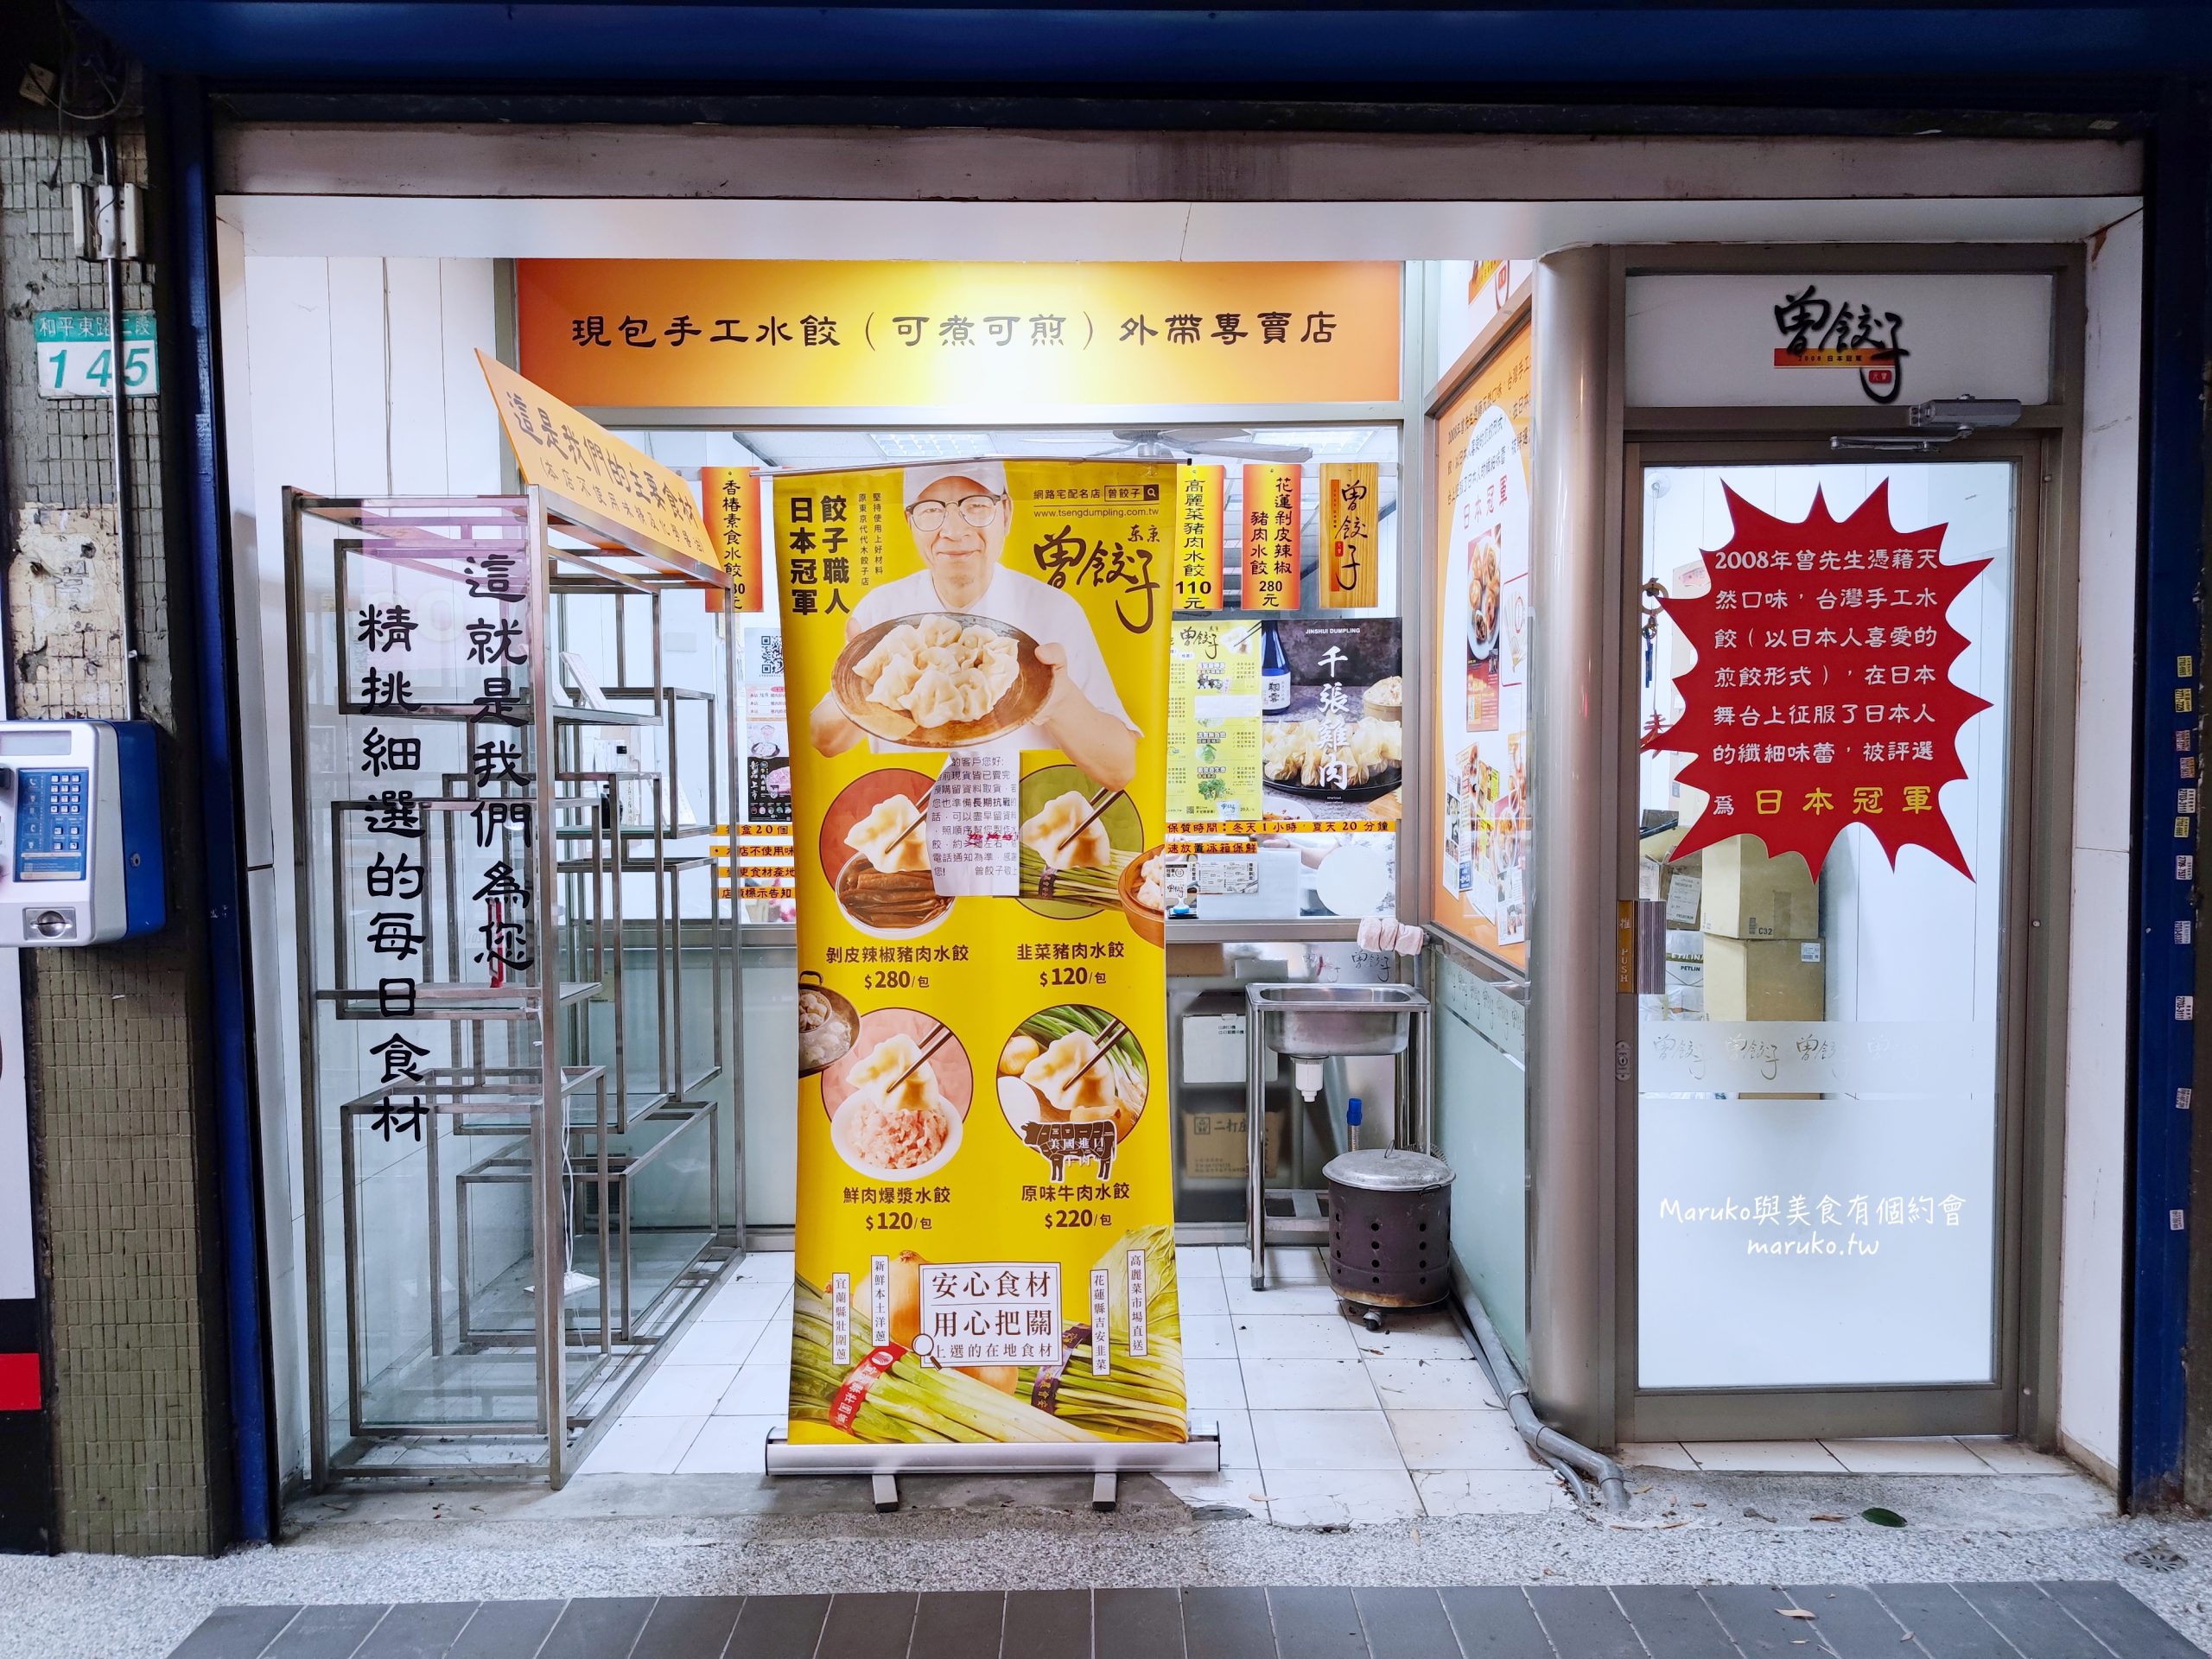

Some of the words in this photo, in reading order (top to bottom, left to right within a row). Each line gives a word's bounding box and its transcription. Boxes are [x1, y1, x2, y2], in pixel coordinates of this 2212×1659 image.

[40, 316, 150, 337] 和平東路二段
[506, 391, 699, 529] 這是我們的主要食材
[1033, 488, 1101, 500] 網路宅配名店
[1108, 488, 1141, 499] 曾餃子
[1033, 508, 1160, 518] www.tsengdumpling.com.tw
[722, 480, 742, 578] 香椿素食水餃
[873, 493, 883, 575] 堅持使用上好材料
[1183, 479, 1205, 577] 高麗菜豬肉水餃
[1274, 477, 1294, 575] 花蓮剝皮辣椒
[859, 493, 869, 586] 原東京代代木餃子店
[1250, 511, 1269, 575] 豬肉水餃
[789, 497, 817, 615] 日本冠軍
[821, 494, 850, 614] 餃子職人
[1714, 548, 1938, 571] 2008年曾先生憑藉天
[1175, 581, 1211, 594] 110
[1259, 581, 1283, 592] 280
[1184, 597, 1205, 609] 元
[1262, 594, 1280, 607] 元
[1714, 587, 1938, 610] 然口味，台灣手工水
[1713, 626, 1938, 649] 餃（以日本人喜愛的
[1713, 665, 1936, 688] 煎餃形式），在日本
[1317, 645, 1350, 791] 千張雞肉
[1713, 703, 1936, 727] 舞台上征服了日本人
[465, 554, 535, 971] 這就是我們為您
[1713, 741, 1934, 765] 的纖細味蕾，被評選
[1756, 785, 1933, 816] 日本冠軍
[1167, 842, 1257, 854] 速放置冰箱保鮮
[357, 603, 430, 1143] 精挑細選的每日食材
[1619, 917, 1631, 930] 推
[826, 944, 969, 963] 剝皮辣椒豬肉水餃
[1016, 941, 1125, 961] 韭菜豬肉水餃
[1039, 967, 1107, 987] $120/包
[1619, 949, 1630, 982] PUSH
[864, 970, 930, 989] $280/包
[842, 1185, 951, 1205] 鮮肉爆漿水餃
[1020, 1183, 1130, 1202] 原味牛肉水餃
[865, 1211, 932, 1231] $120/包
[1044, 1209, 1112, 1230] $220/包
[931, 1269, 1052, 1299] 安心食材
[1130, 1255, 1143, 1352] 高麗菜市場直送
[933, 1309, 1052, 1338] 用心把關
[1094, 1274, 1107, 1372] 花蓮縣吉安韭菜
[932, 1343, 1052, 1359] 上選的在地食材
